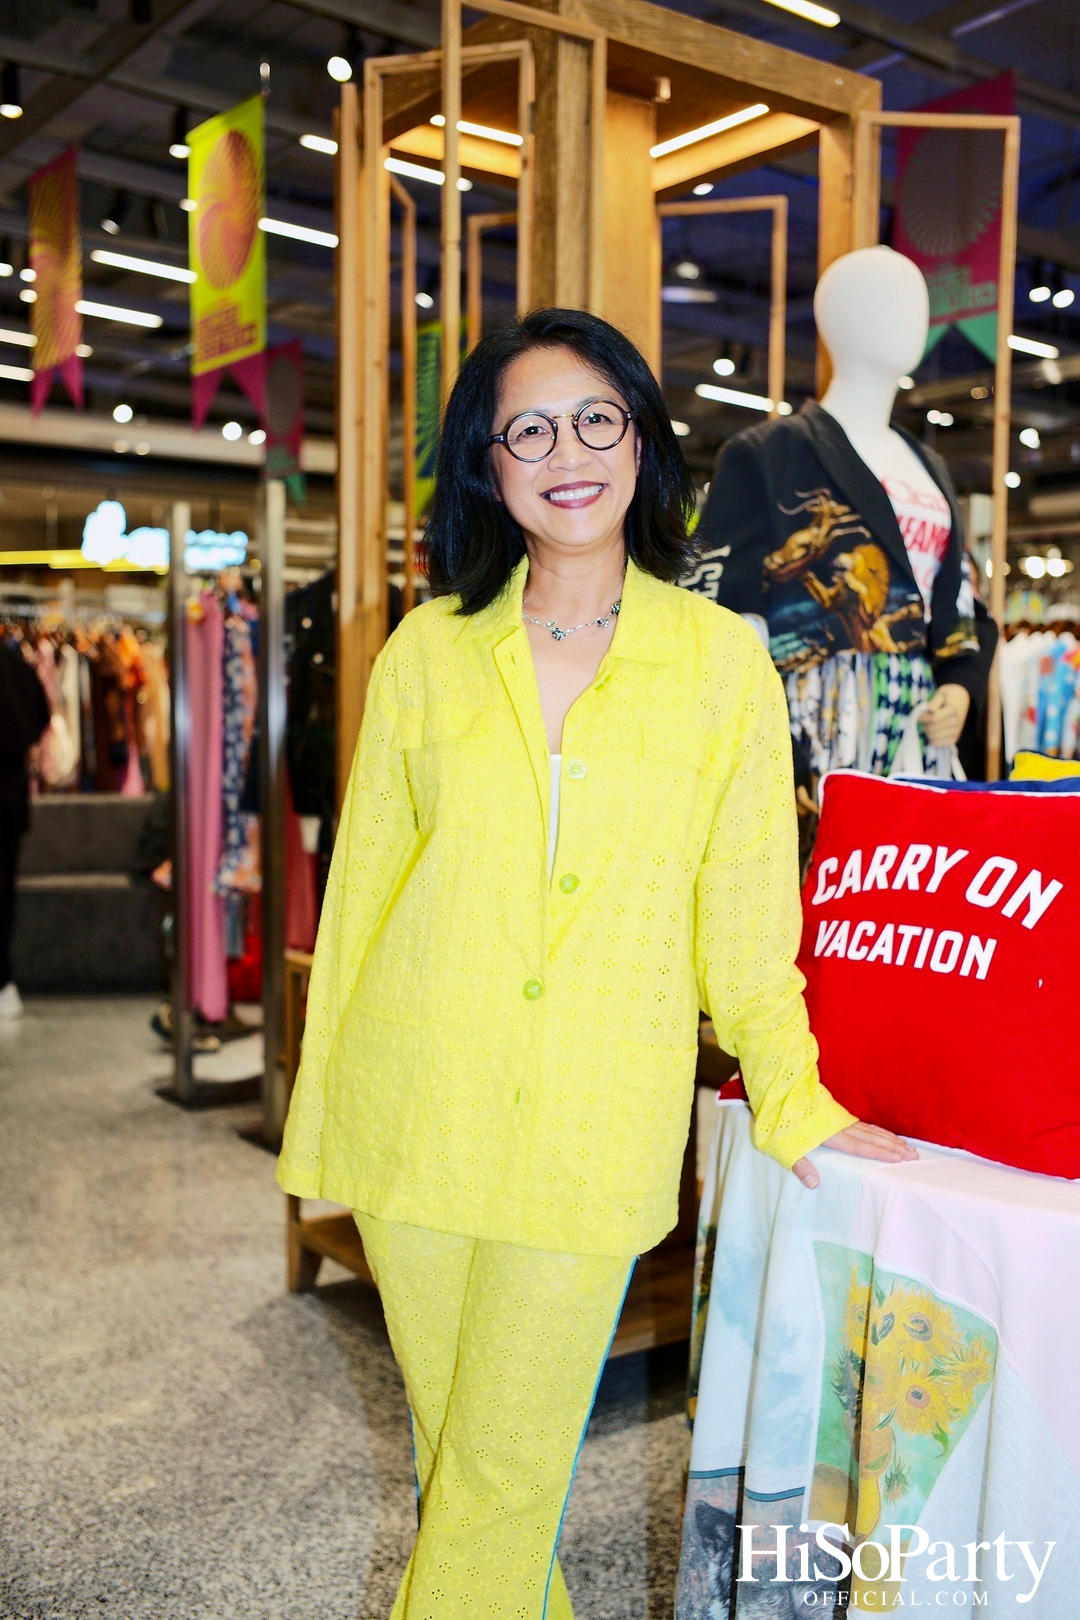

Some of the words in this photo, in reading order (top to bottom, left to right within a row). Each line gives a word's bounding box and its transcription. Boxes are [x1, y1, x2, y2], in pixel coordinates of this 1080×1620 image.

[811, 844, 969, 905] CARRY
[965, 855, 1064, 930] ON
[814, 920, 998, 981] VACATION
